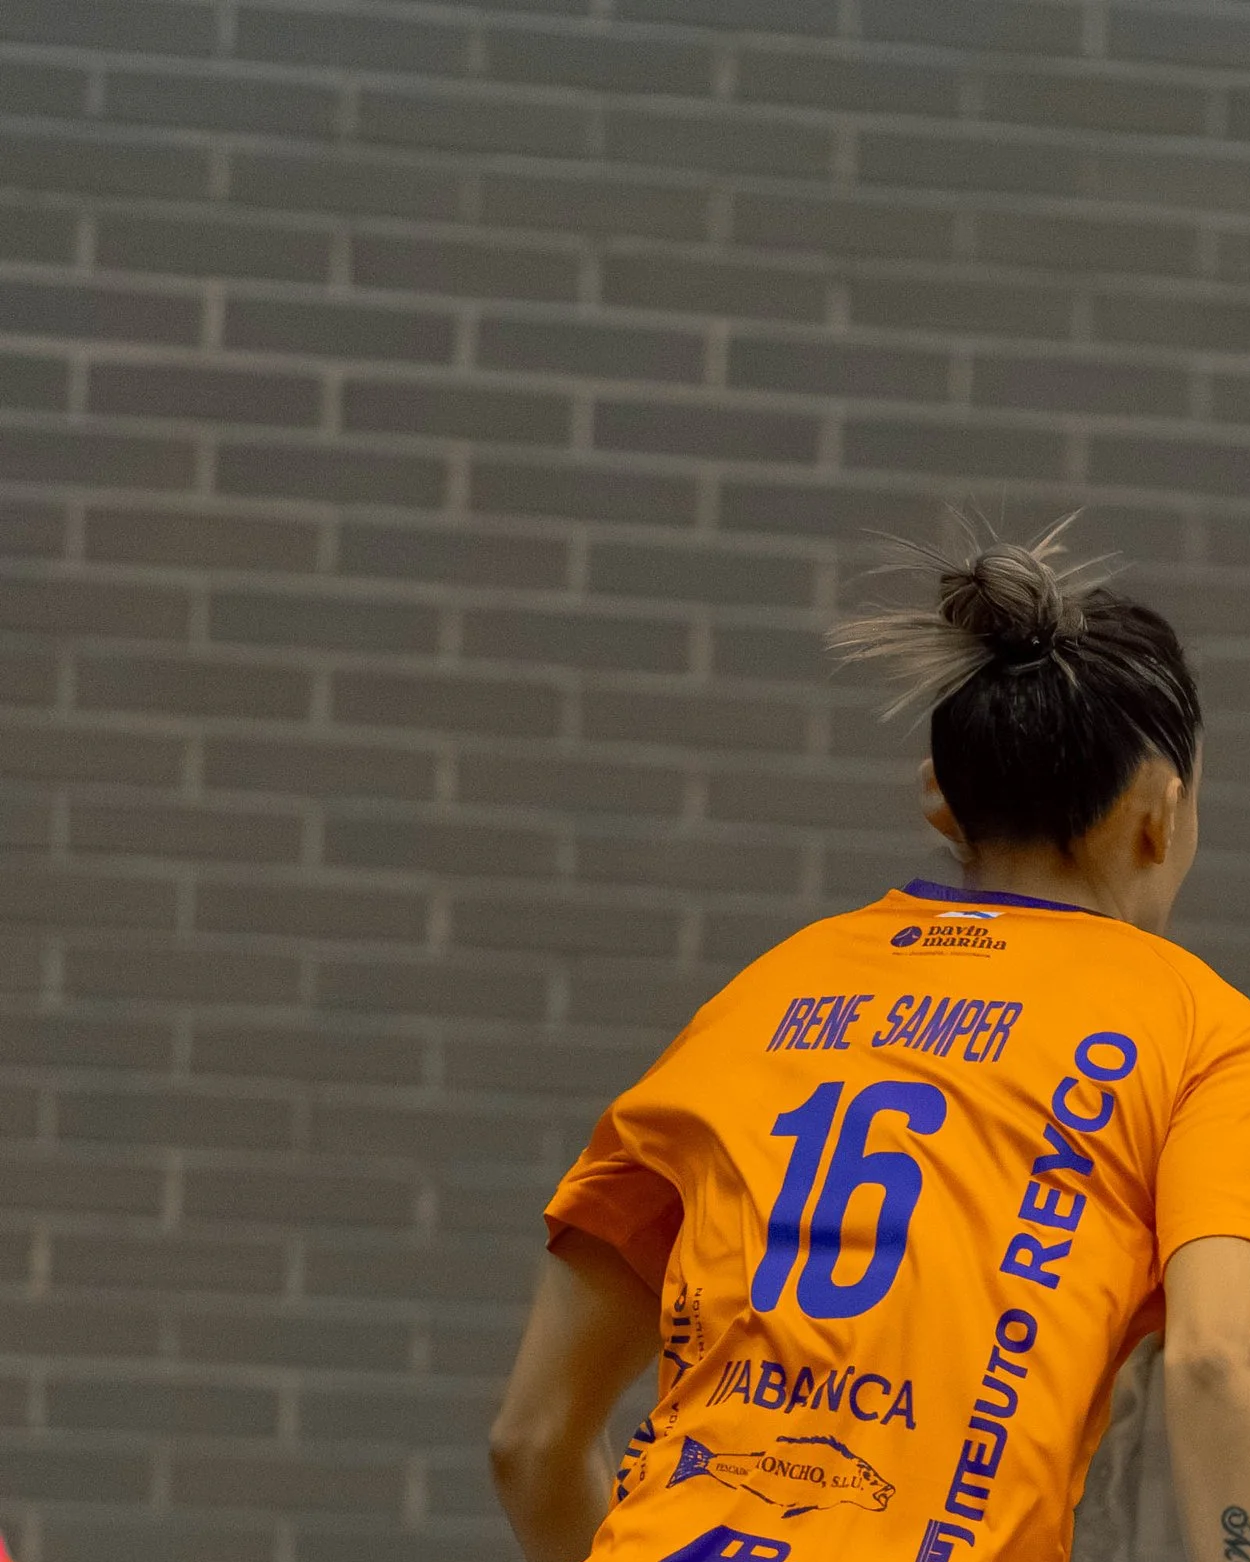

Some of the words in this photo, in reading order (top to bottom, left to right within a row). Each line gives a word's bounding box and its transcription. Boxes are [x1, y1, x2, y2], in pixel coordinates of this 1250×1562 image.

[766, 994, 875, 1053] IRENE
[872, 994, 1024, 1063] SAMPER
[999, 1030, 1139, 1290] REYCO
[750, 1080, 948, 1319] 16
[705, 1358, 916, 1430] ABANCA
[756, 1456, 827, 1488] ONCHO,
